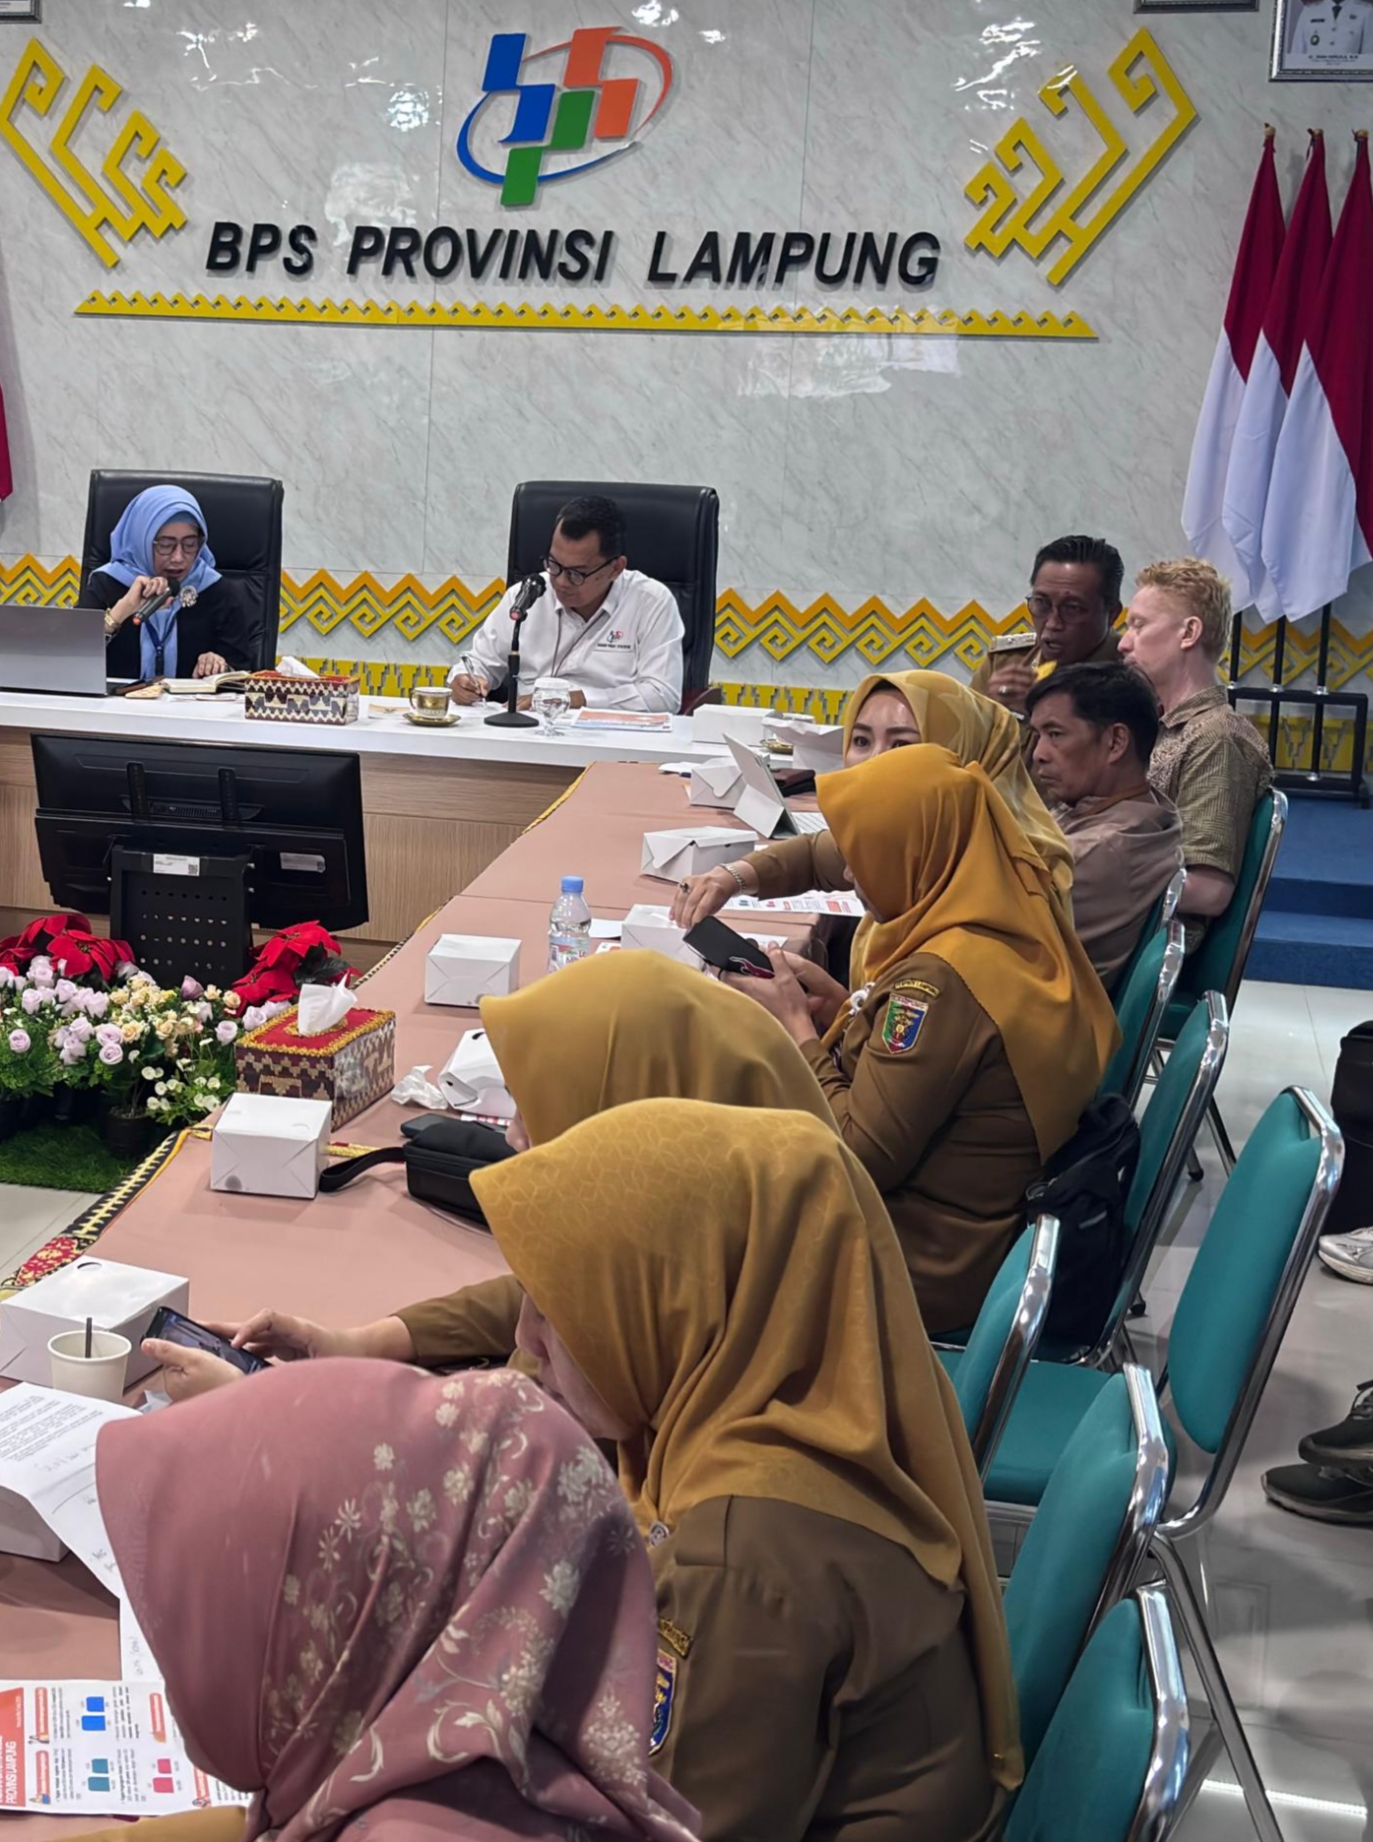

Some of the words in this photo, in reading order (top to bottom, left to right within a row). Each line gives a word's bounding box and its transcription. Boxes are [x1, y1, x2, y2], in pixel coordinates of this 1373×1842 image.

[205, 221, 317, 275] BPS
[346, 225, 615, 282] PROVINSI
[647, 230, 941, 286] LAMPUNG
[4, 1740, 17, 1772] LAMPUNG
[4, 1773, 17, 1805] PROVINSI
